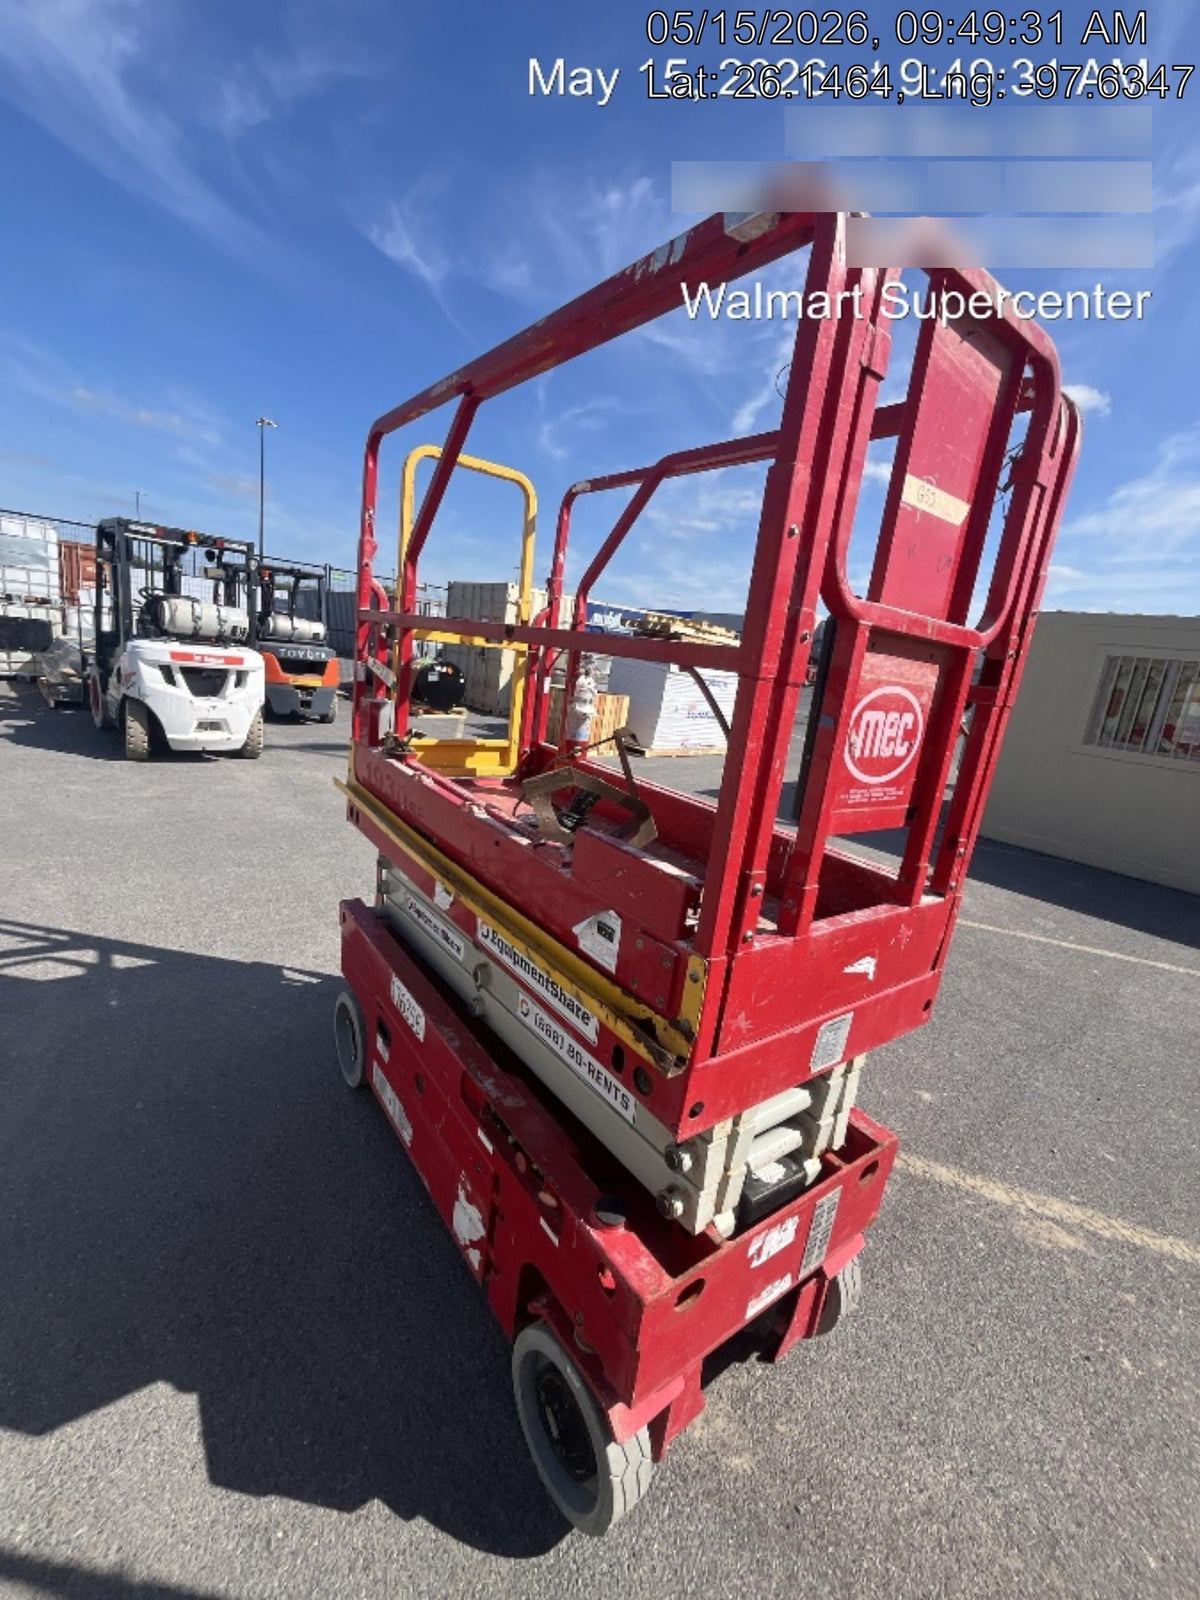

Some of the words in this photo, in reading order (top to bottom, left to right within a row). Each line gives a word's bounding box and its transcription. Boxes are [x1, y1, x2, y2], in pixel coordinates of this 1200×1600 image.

[490, 931, 592, 1026] EquipmentShare
[534, 1009, 565, 1050] (888)
[568, 1042, 631, 1111] 80-RENTS
